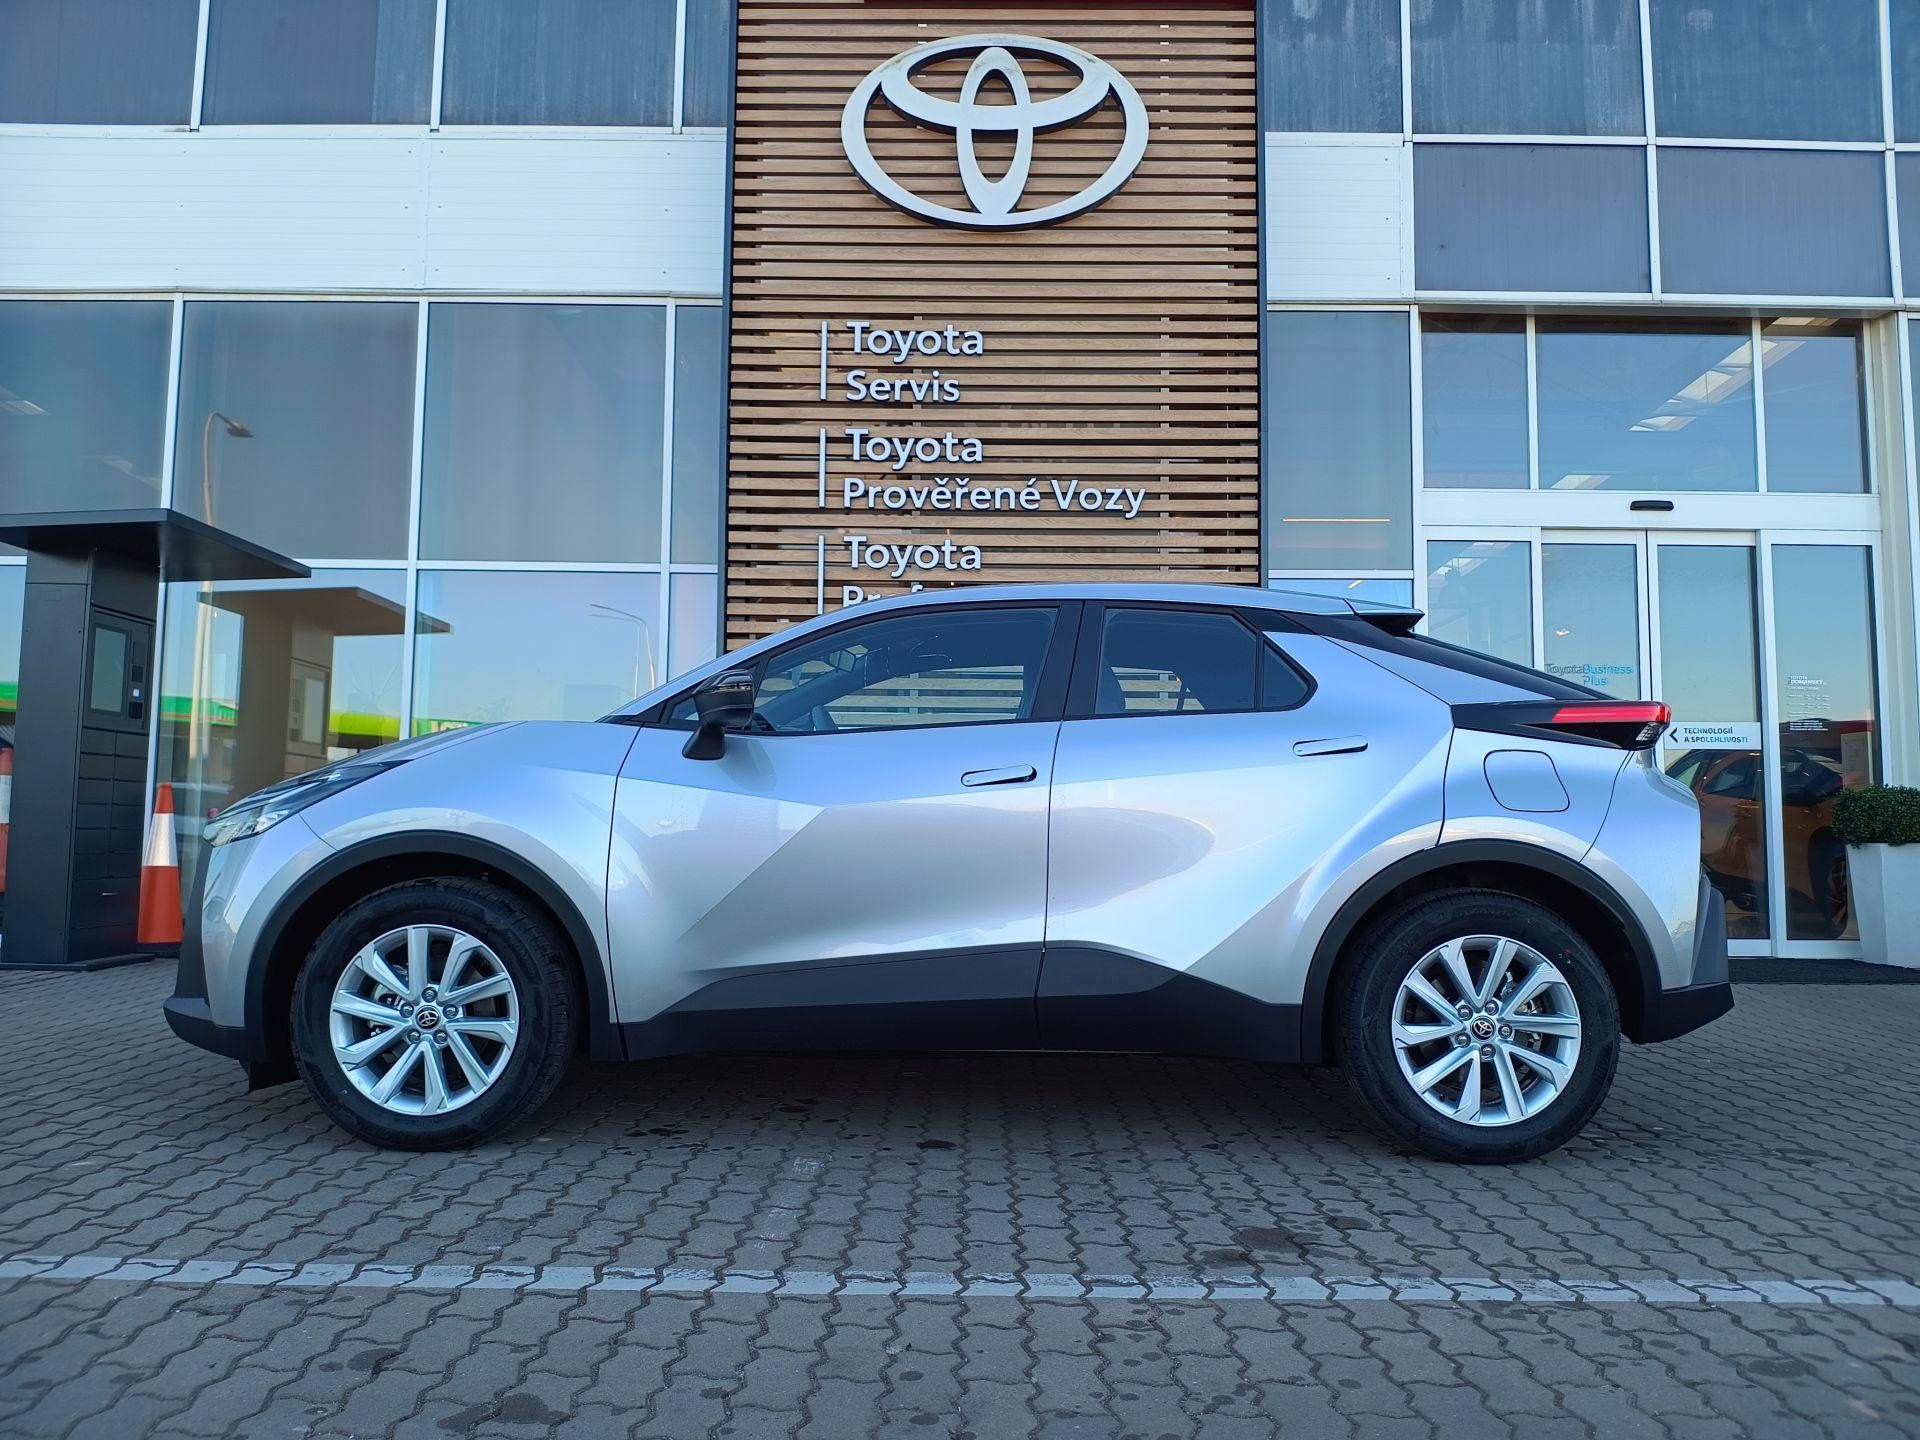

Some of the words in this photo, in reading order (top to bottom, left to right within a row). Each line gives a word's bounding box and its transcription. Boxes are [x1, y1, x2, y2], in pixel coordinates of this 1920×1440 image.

[846, 320, 985, 363] Toyota
[846, 370, 961, 402] Servis
[844, 428, 984, 471] Toyota
[843, 477, 1041, 511] Prověřené
[1050, 479, 1147, 519] Vozy
[843, 535, 982, 578] Toyota
[1583, 675, 1608, 686] Plus
[1683, 726, 1733, 735] TECHNOLOGIÍ
